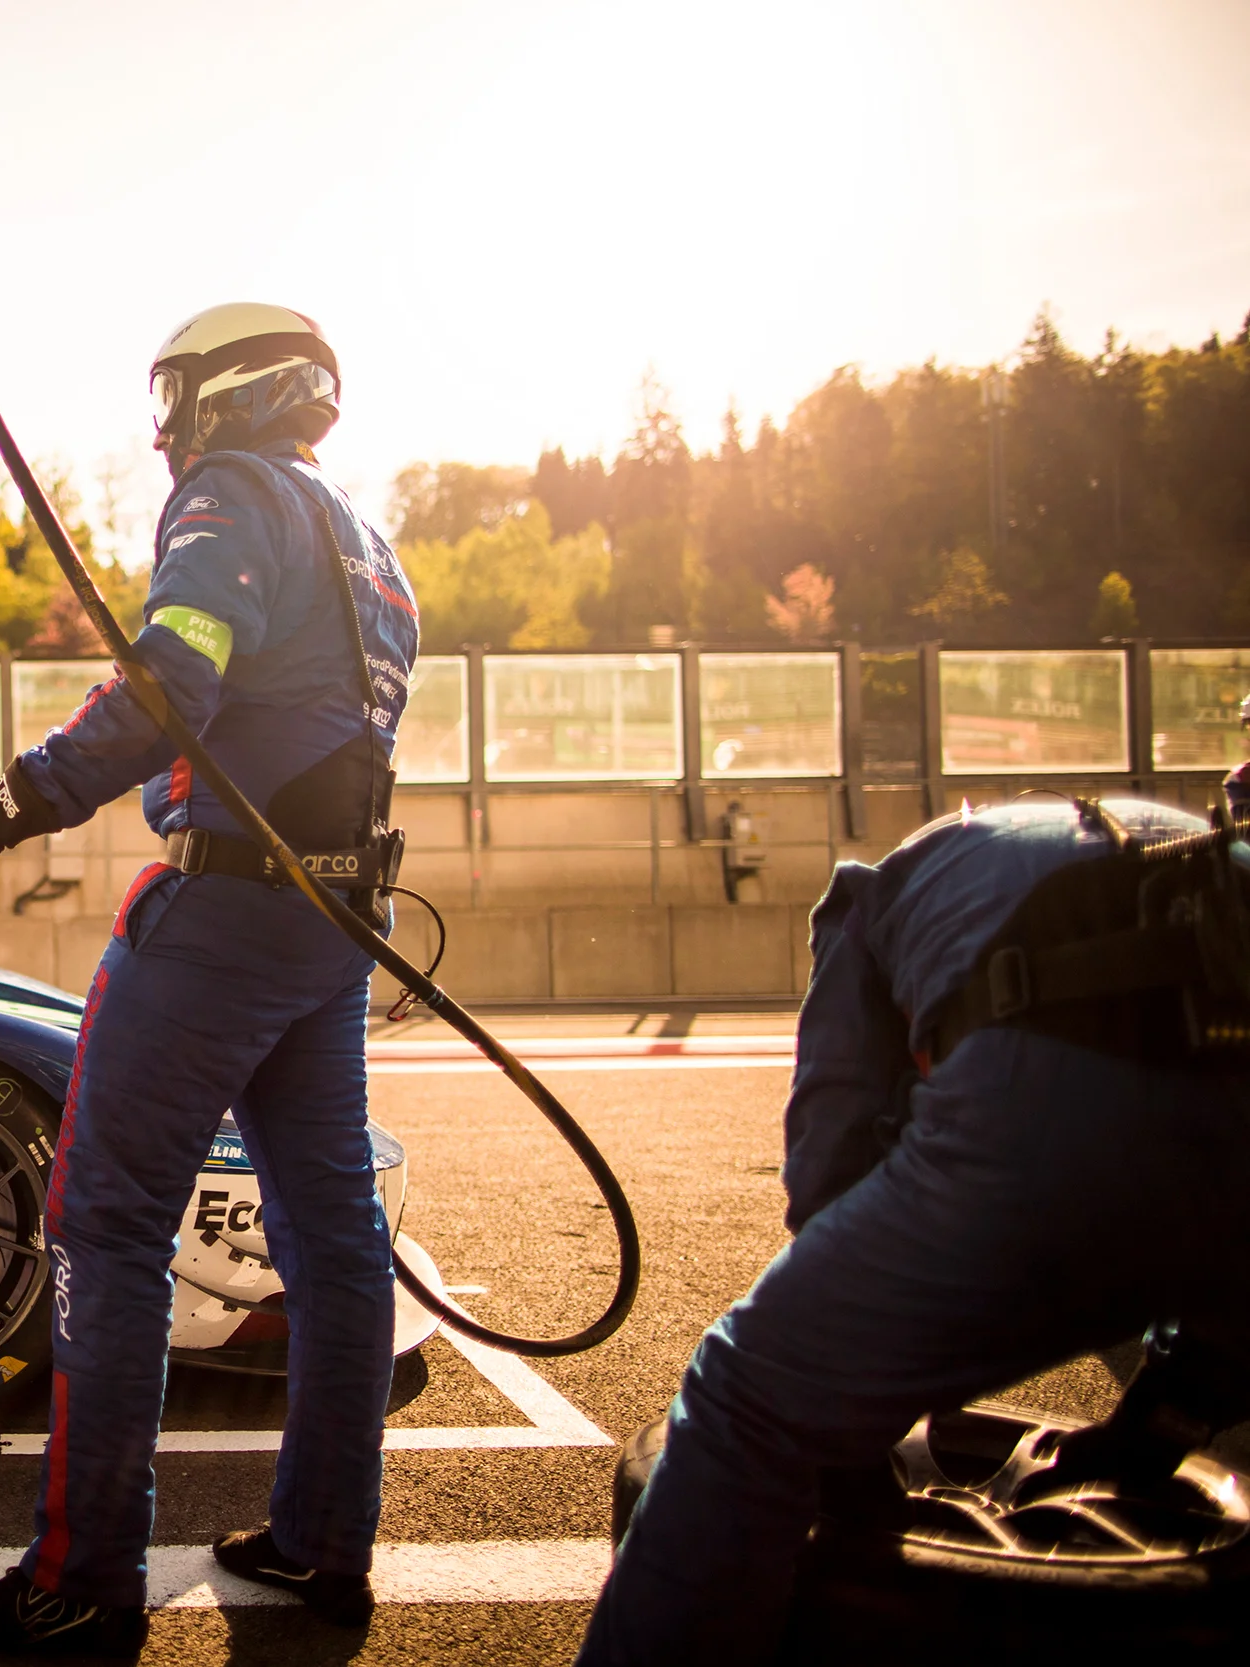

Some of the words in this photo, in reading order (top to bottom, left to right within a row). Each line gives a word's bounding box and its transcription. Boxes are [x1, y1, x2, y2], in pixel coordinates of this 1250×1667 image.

[186, 499, 211, 511] Ford
[188, 615, 216, 634] PIT
[176, 626, 217, 652] LANE
[50, 1244, 71, 1342] FORD
